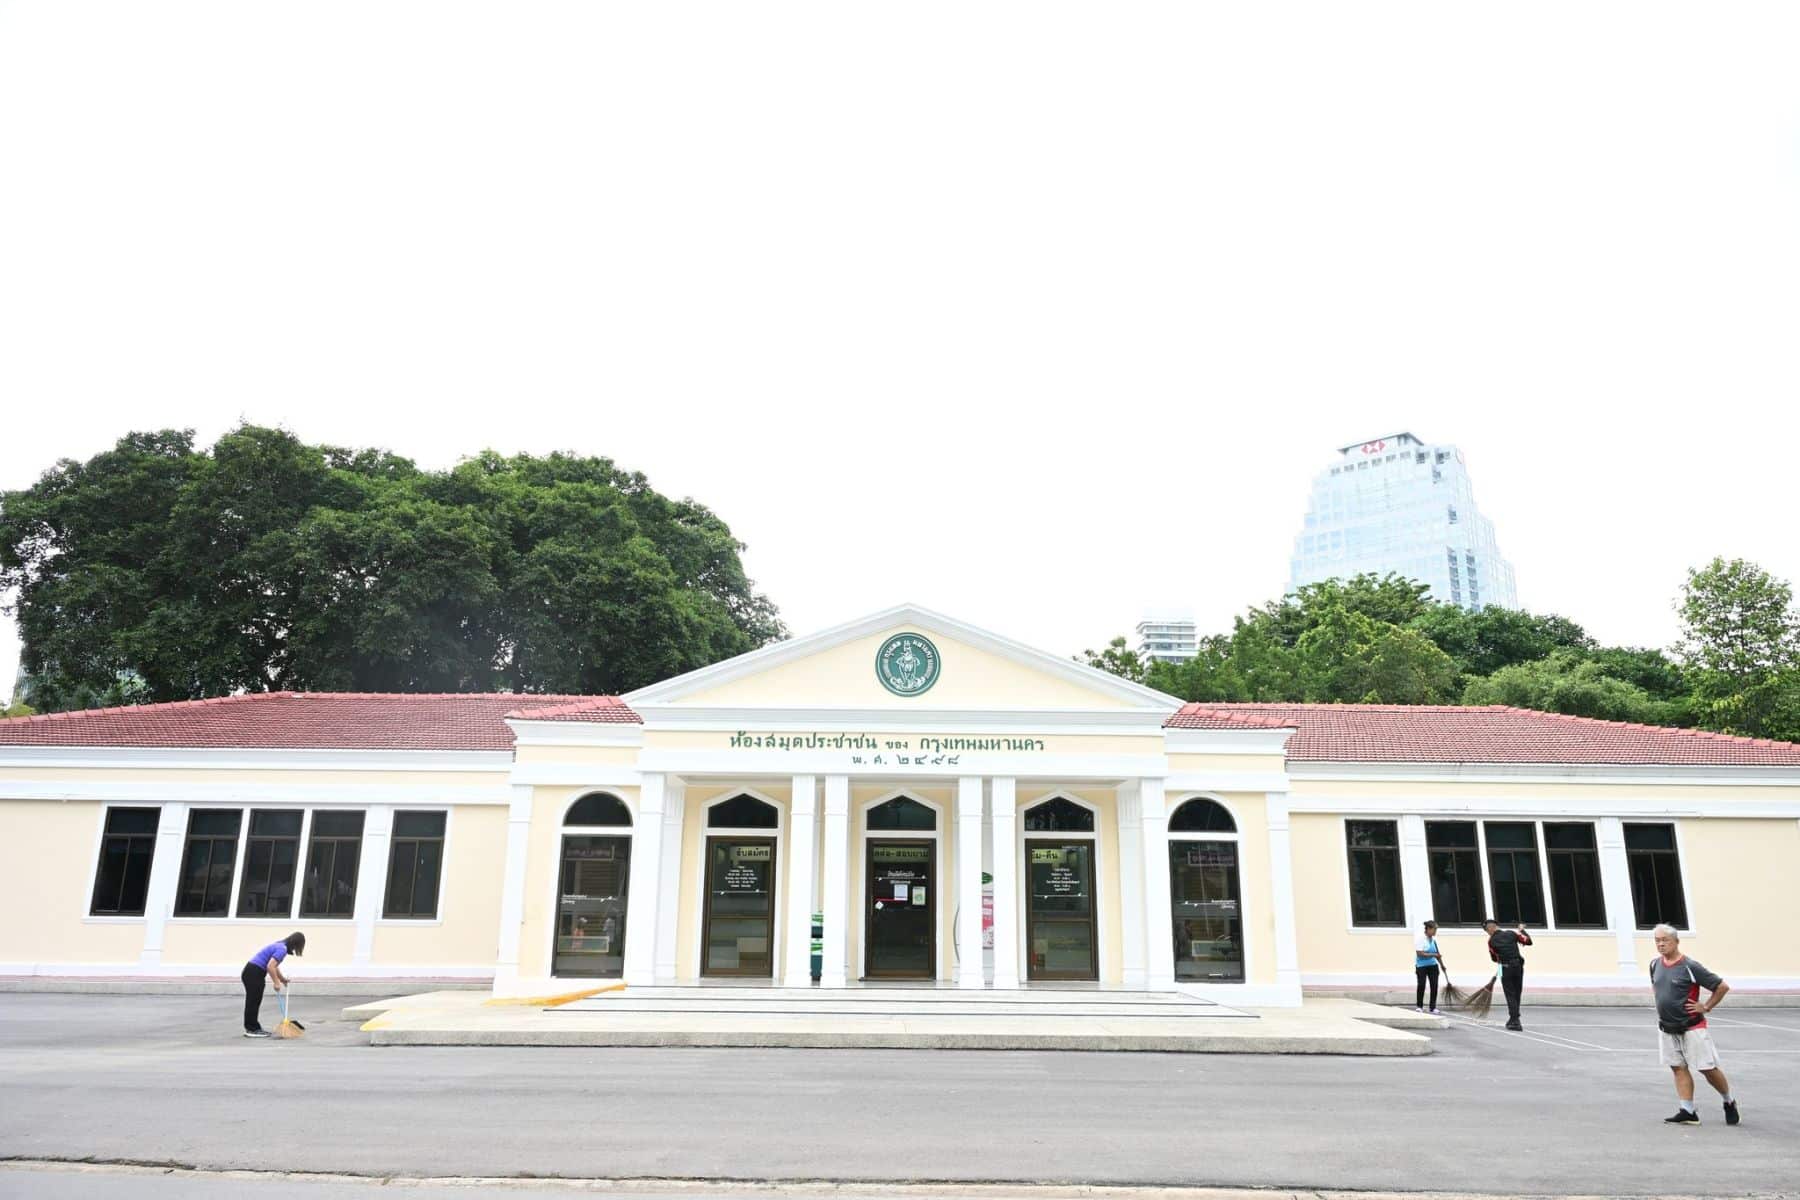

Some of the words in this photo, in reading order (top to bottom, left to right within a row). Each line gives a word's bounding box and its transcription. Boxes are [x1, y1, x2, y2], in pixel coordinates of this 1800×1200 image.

[730, 730, 878, 751] ห้องสมุดประชาชน
[885, 740, 908, 749] ของ
[920, 737, 1044, 753] กรุงเทพมหานคร
